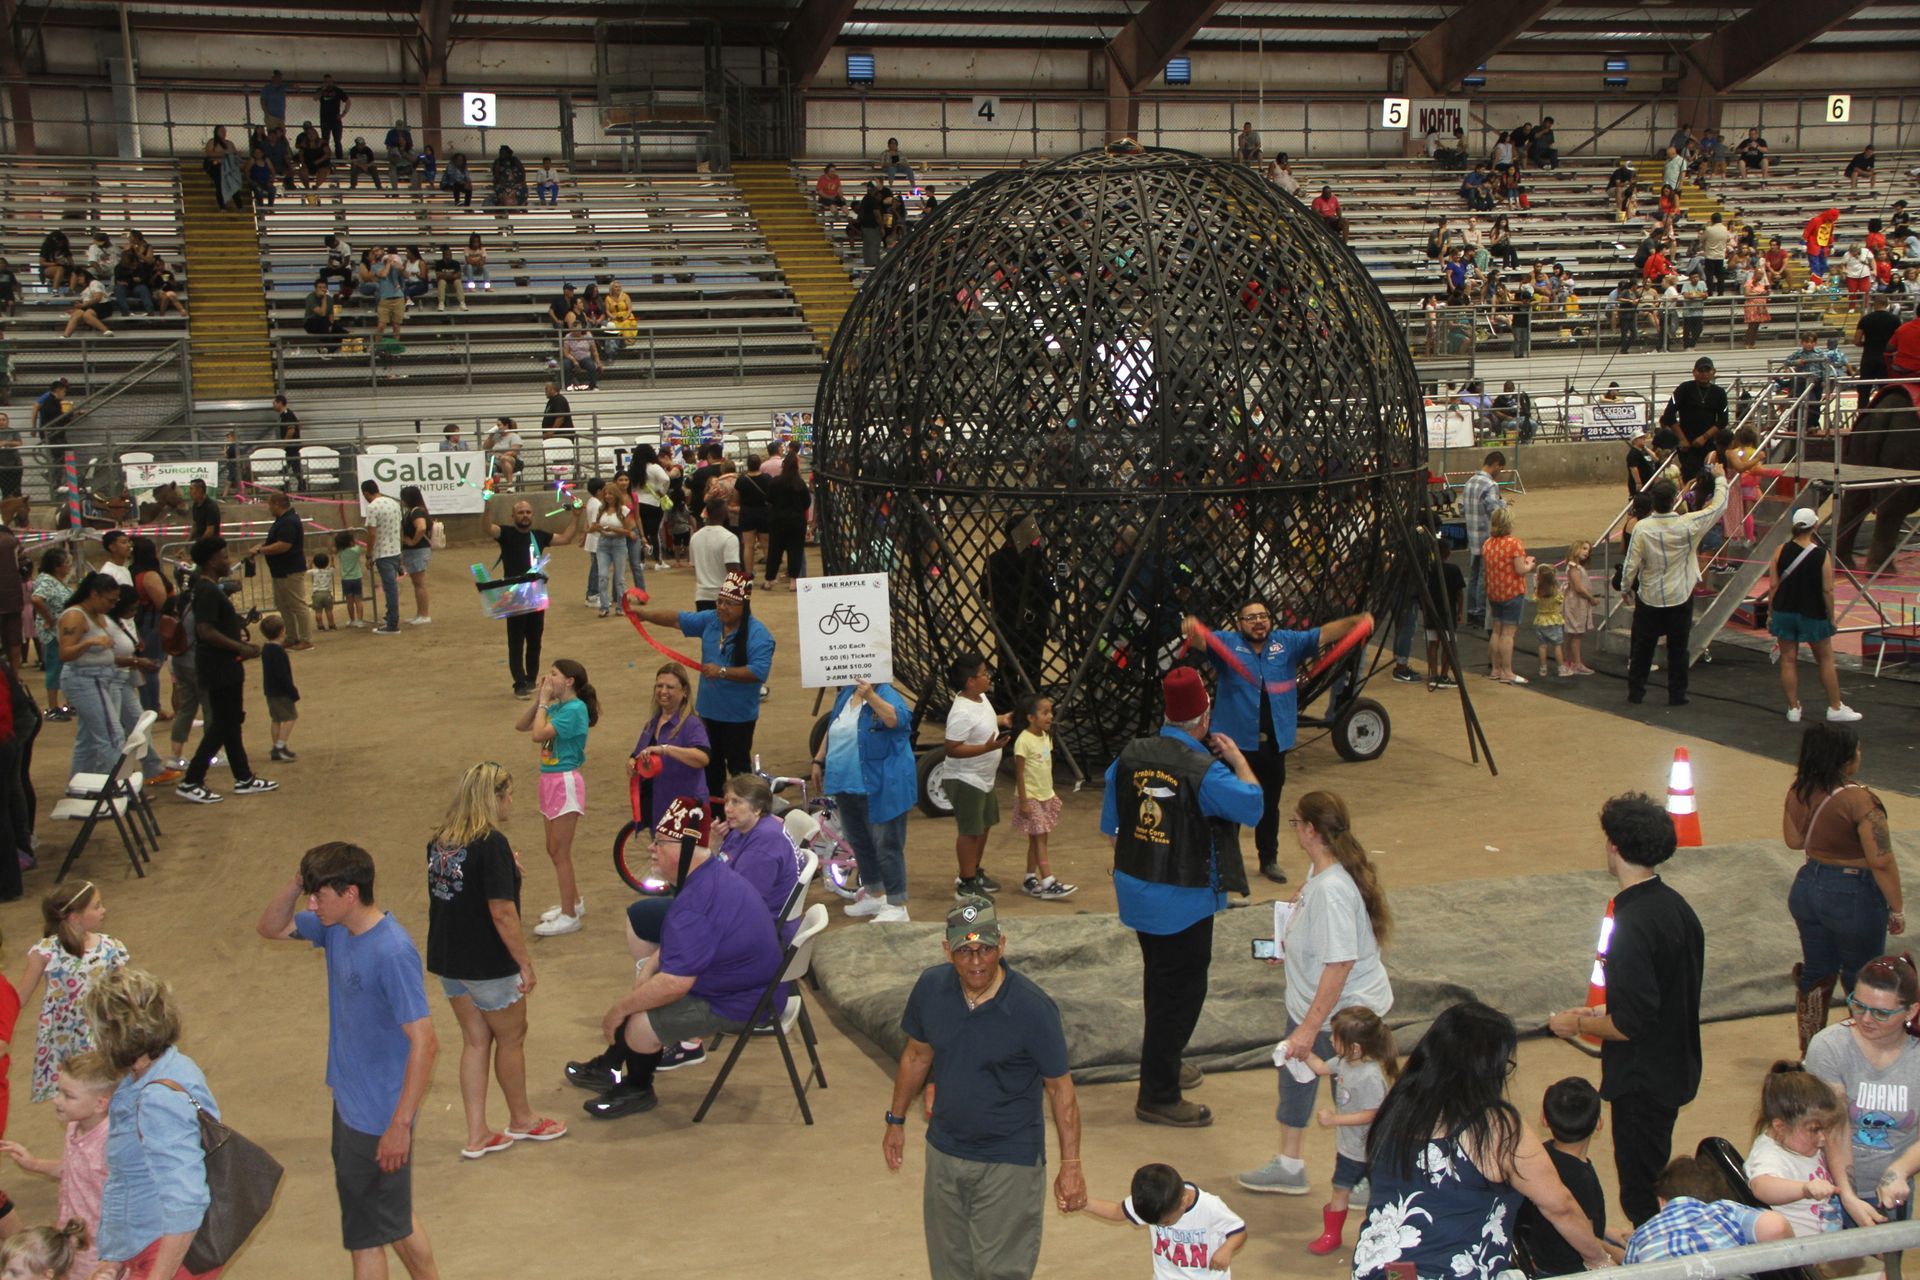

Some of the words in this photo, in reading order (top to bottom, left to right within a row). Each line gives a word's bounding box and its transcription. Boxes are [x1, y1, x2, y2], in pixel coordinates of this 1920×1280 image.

[471, 97, 487, 122] 3
[978, 99, 995, 122] 4
[1389, 103, 1401, 124] 5
[1832, 98, 1844, 119] 6
[1419, 107, 1461, 133] NORTH
[158, 467, 209, 475] SURGICAL
[400, 483, 455, 492] FNITURE
[1149, 828, 1165, 837] Corp
[1856, 1082, 1908, 1112] OHANA
[1154, 1233, 1208, 1269] MAN
